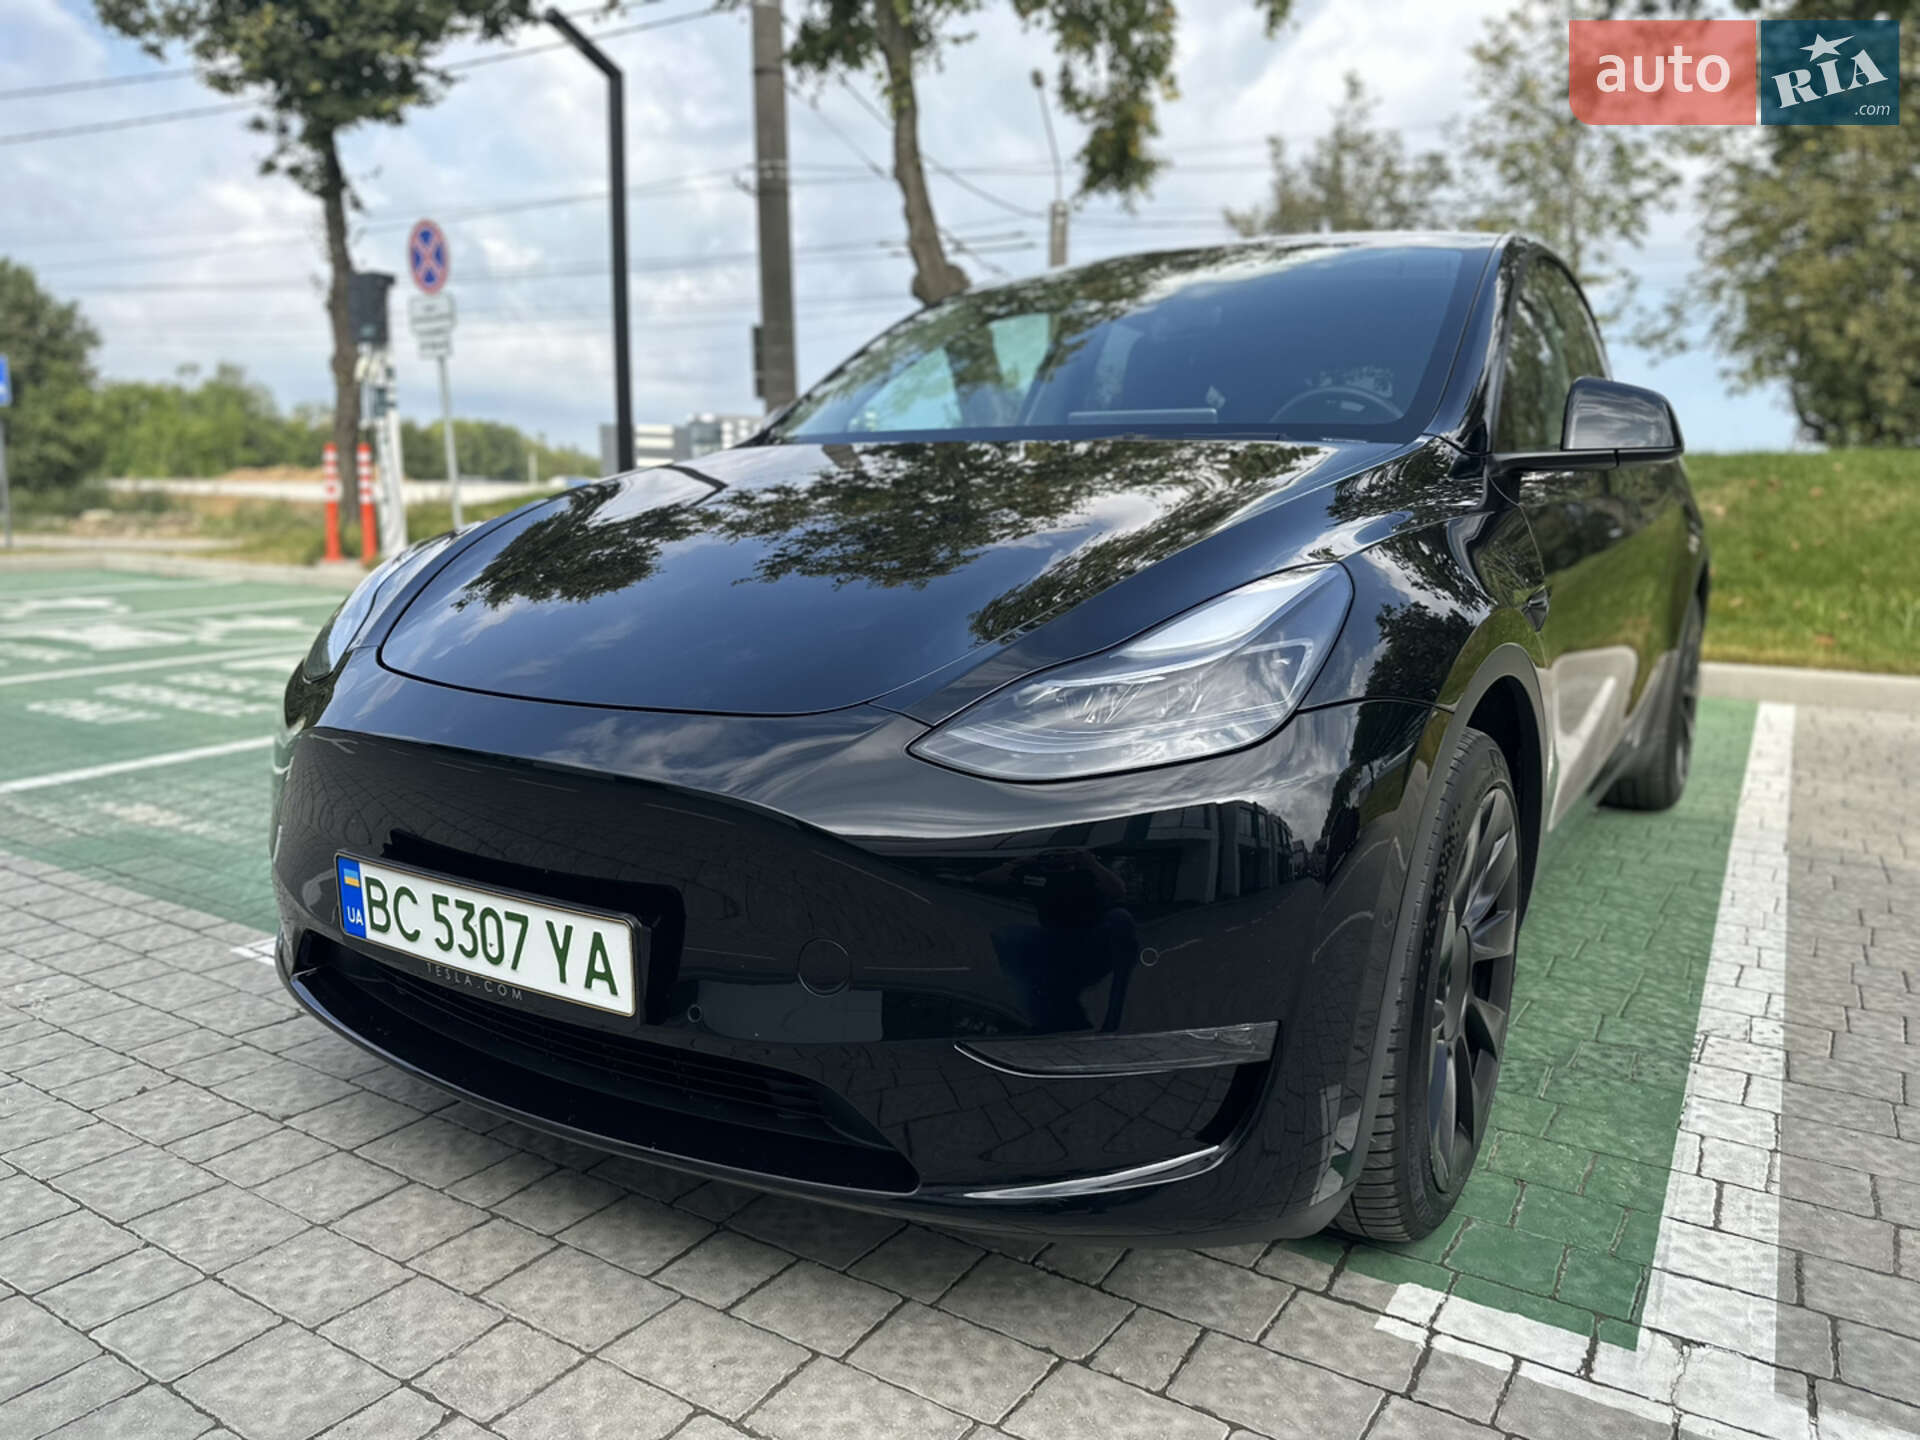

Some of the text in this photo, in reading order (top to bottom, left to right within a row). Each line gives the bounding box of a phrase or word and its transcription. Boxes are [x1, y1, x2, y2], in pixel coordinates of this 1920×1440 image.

[346, 905, 364, 926] UA
[365, 876, 618, 996] BC 5307 YA
[426, 962, 522, 1000] TESLA.COM
